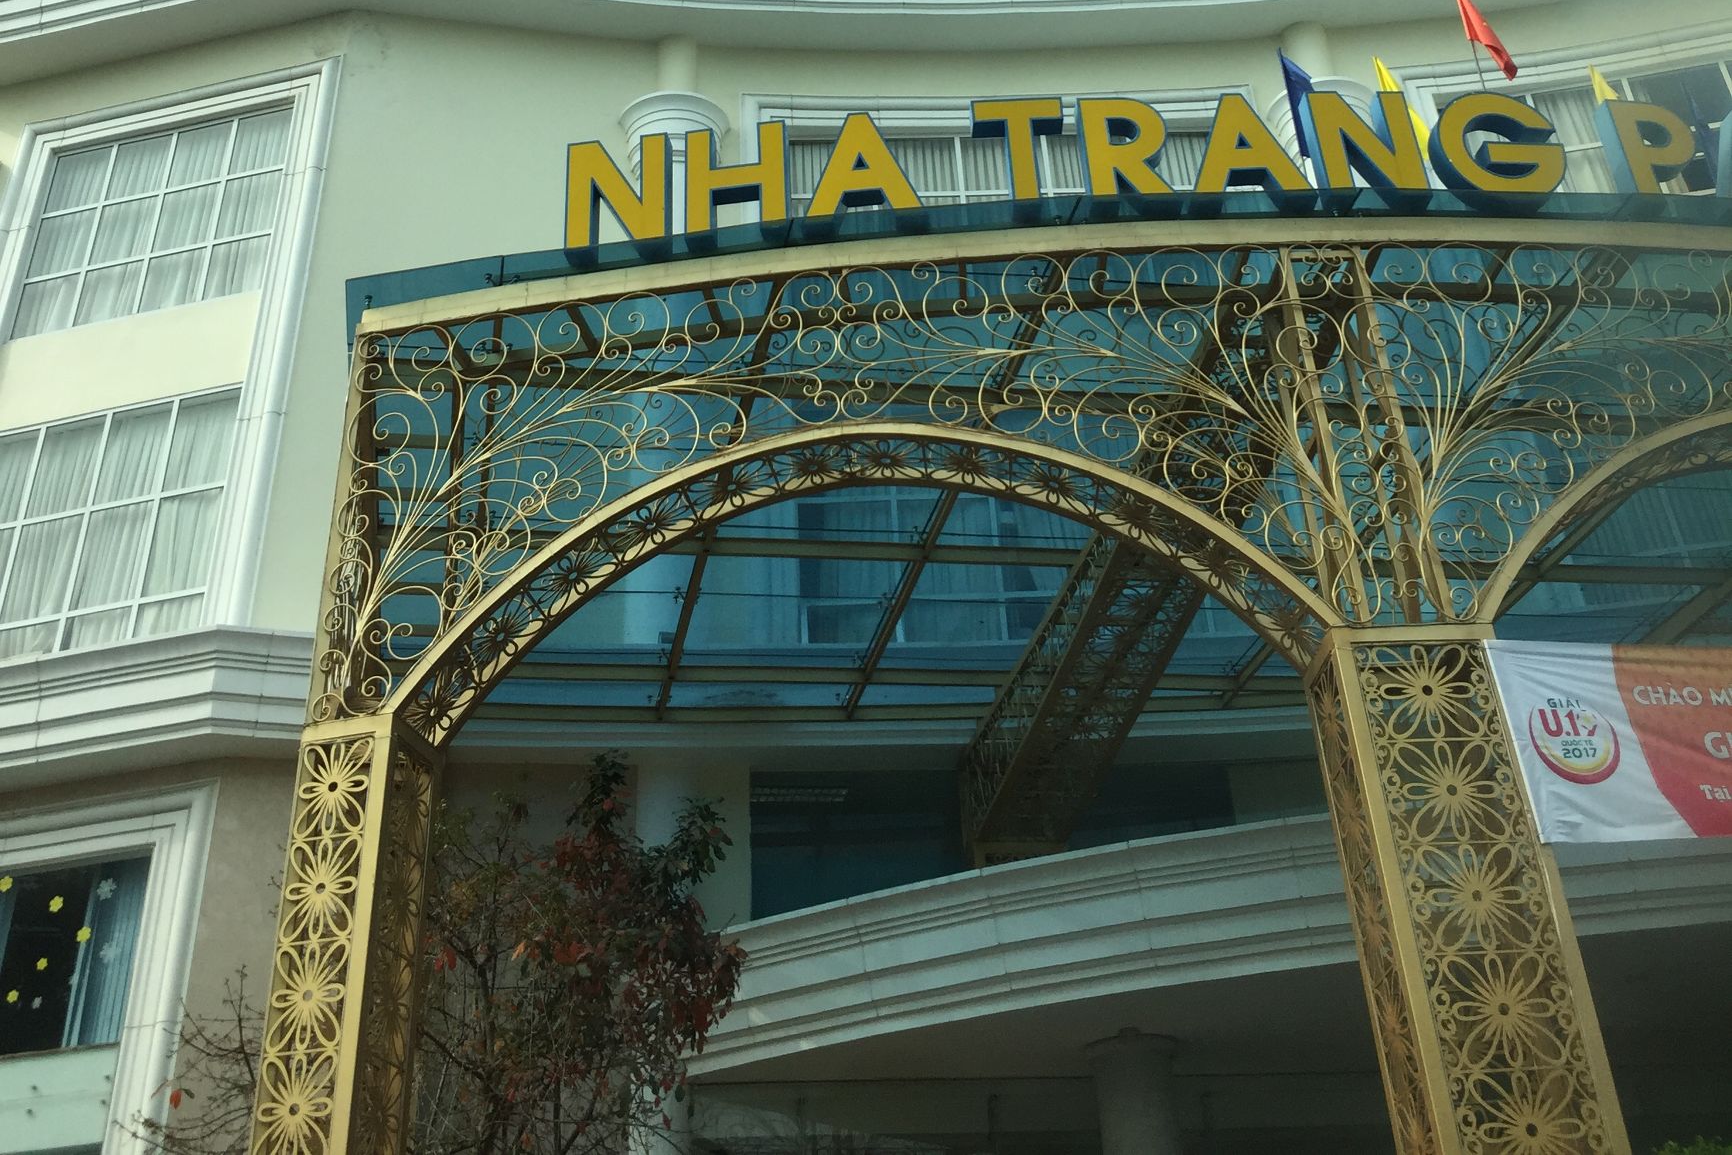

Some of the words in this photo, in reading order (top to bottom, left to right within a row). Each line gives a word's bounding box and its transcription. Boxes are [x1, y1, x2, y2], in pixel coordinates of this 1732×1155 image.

[563, 111, 927, 254] NHA
[969, 91, 1568, 202] TRANG
[1598, 99, 1732, 196] P
[1632, 682, 1703, 706] CHÀO
[1709, 684, 1732, 706] M
[1561, 747, 1597, 759] 2017
